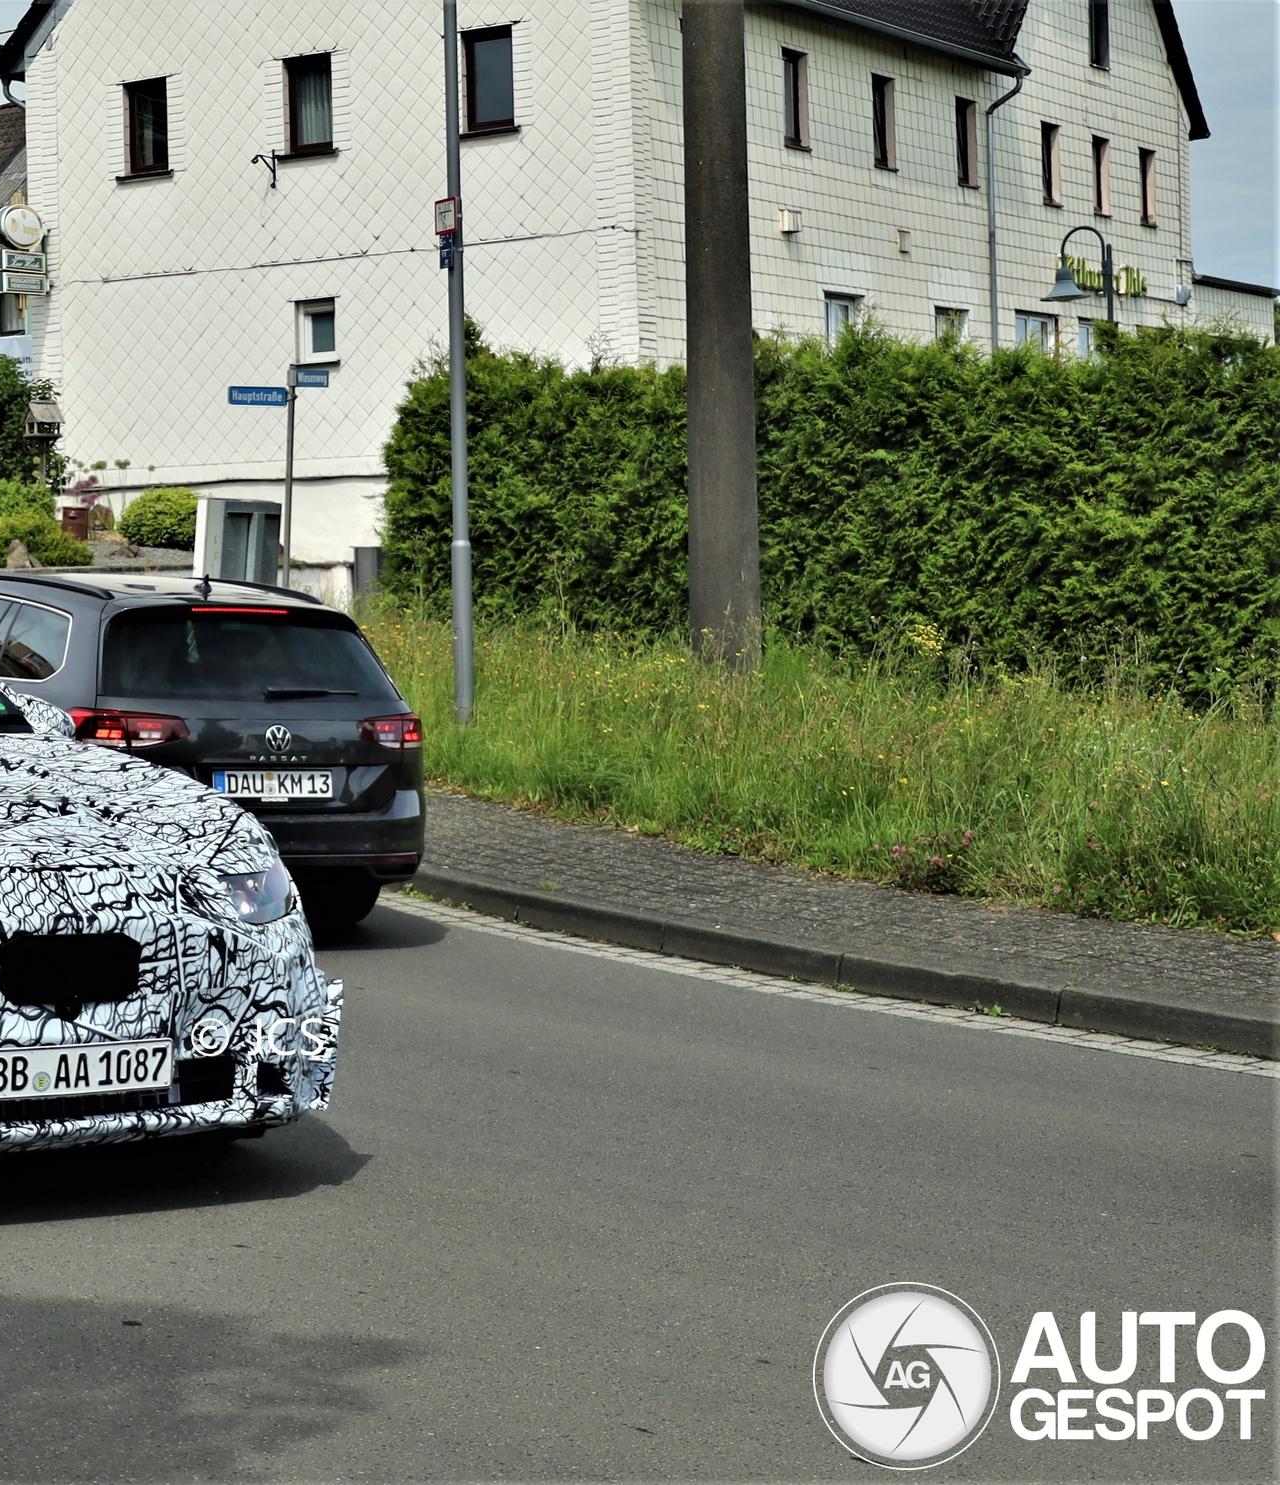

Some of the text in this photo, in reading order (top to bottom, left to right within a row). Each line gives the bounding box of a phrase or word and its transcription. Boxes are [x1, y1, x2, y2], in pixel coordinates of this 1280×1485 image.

[297, 371, 327, 386] Wiesenweg
[231, 389, 283, 404] Hauptstraße
[226, 773, 265, 794] DAU
[277, 773, 302, 794] KM
[307, 773, 330, 794] 13
[53, 1052, 90, 1089] AA
[98, 1047, 168, 1086] 1087
